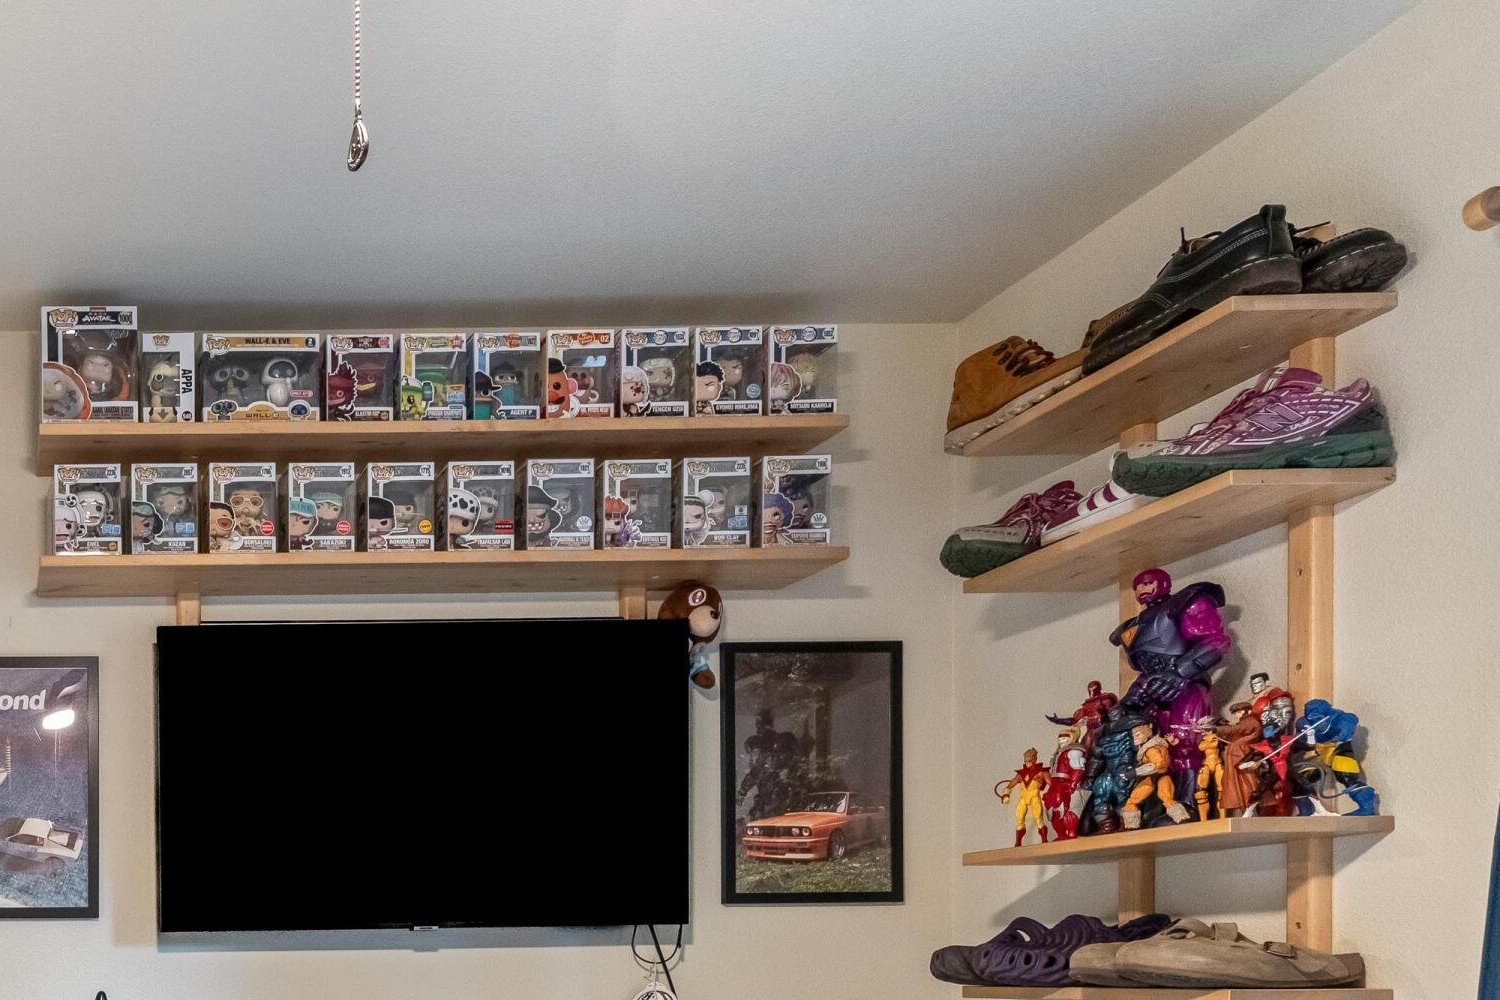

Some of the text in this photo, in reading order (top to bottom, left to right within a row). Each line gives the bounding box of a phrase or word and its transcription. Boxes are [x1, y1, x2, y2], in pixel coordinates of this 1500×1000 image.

[51, 308, 78, 324] POP!
[245, 336, 269, 345] WALL-E
[278, 336, 291, 345] EVE
[600, 334, 609, 342] 02
[206, 338, 230, 350] POP!
[181, 368, 193, 394] APPA
[415, 538, 430, 546] ZORO
